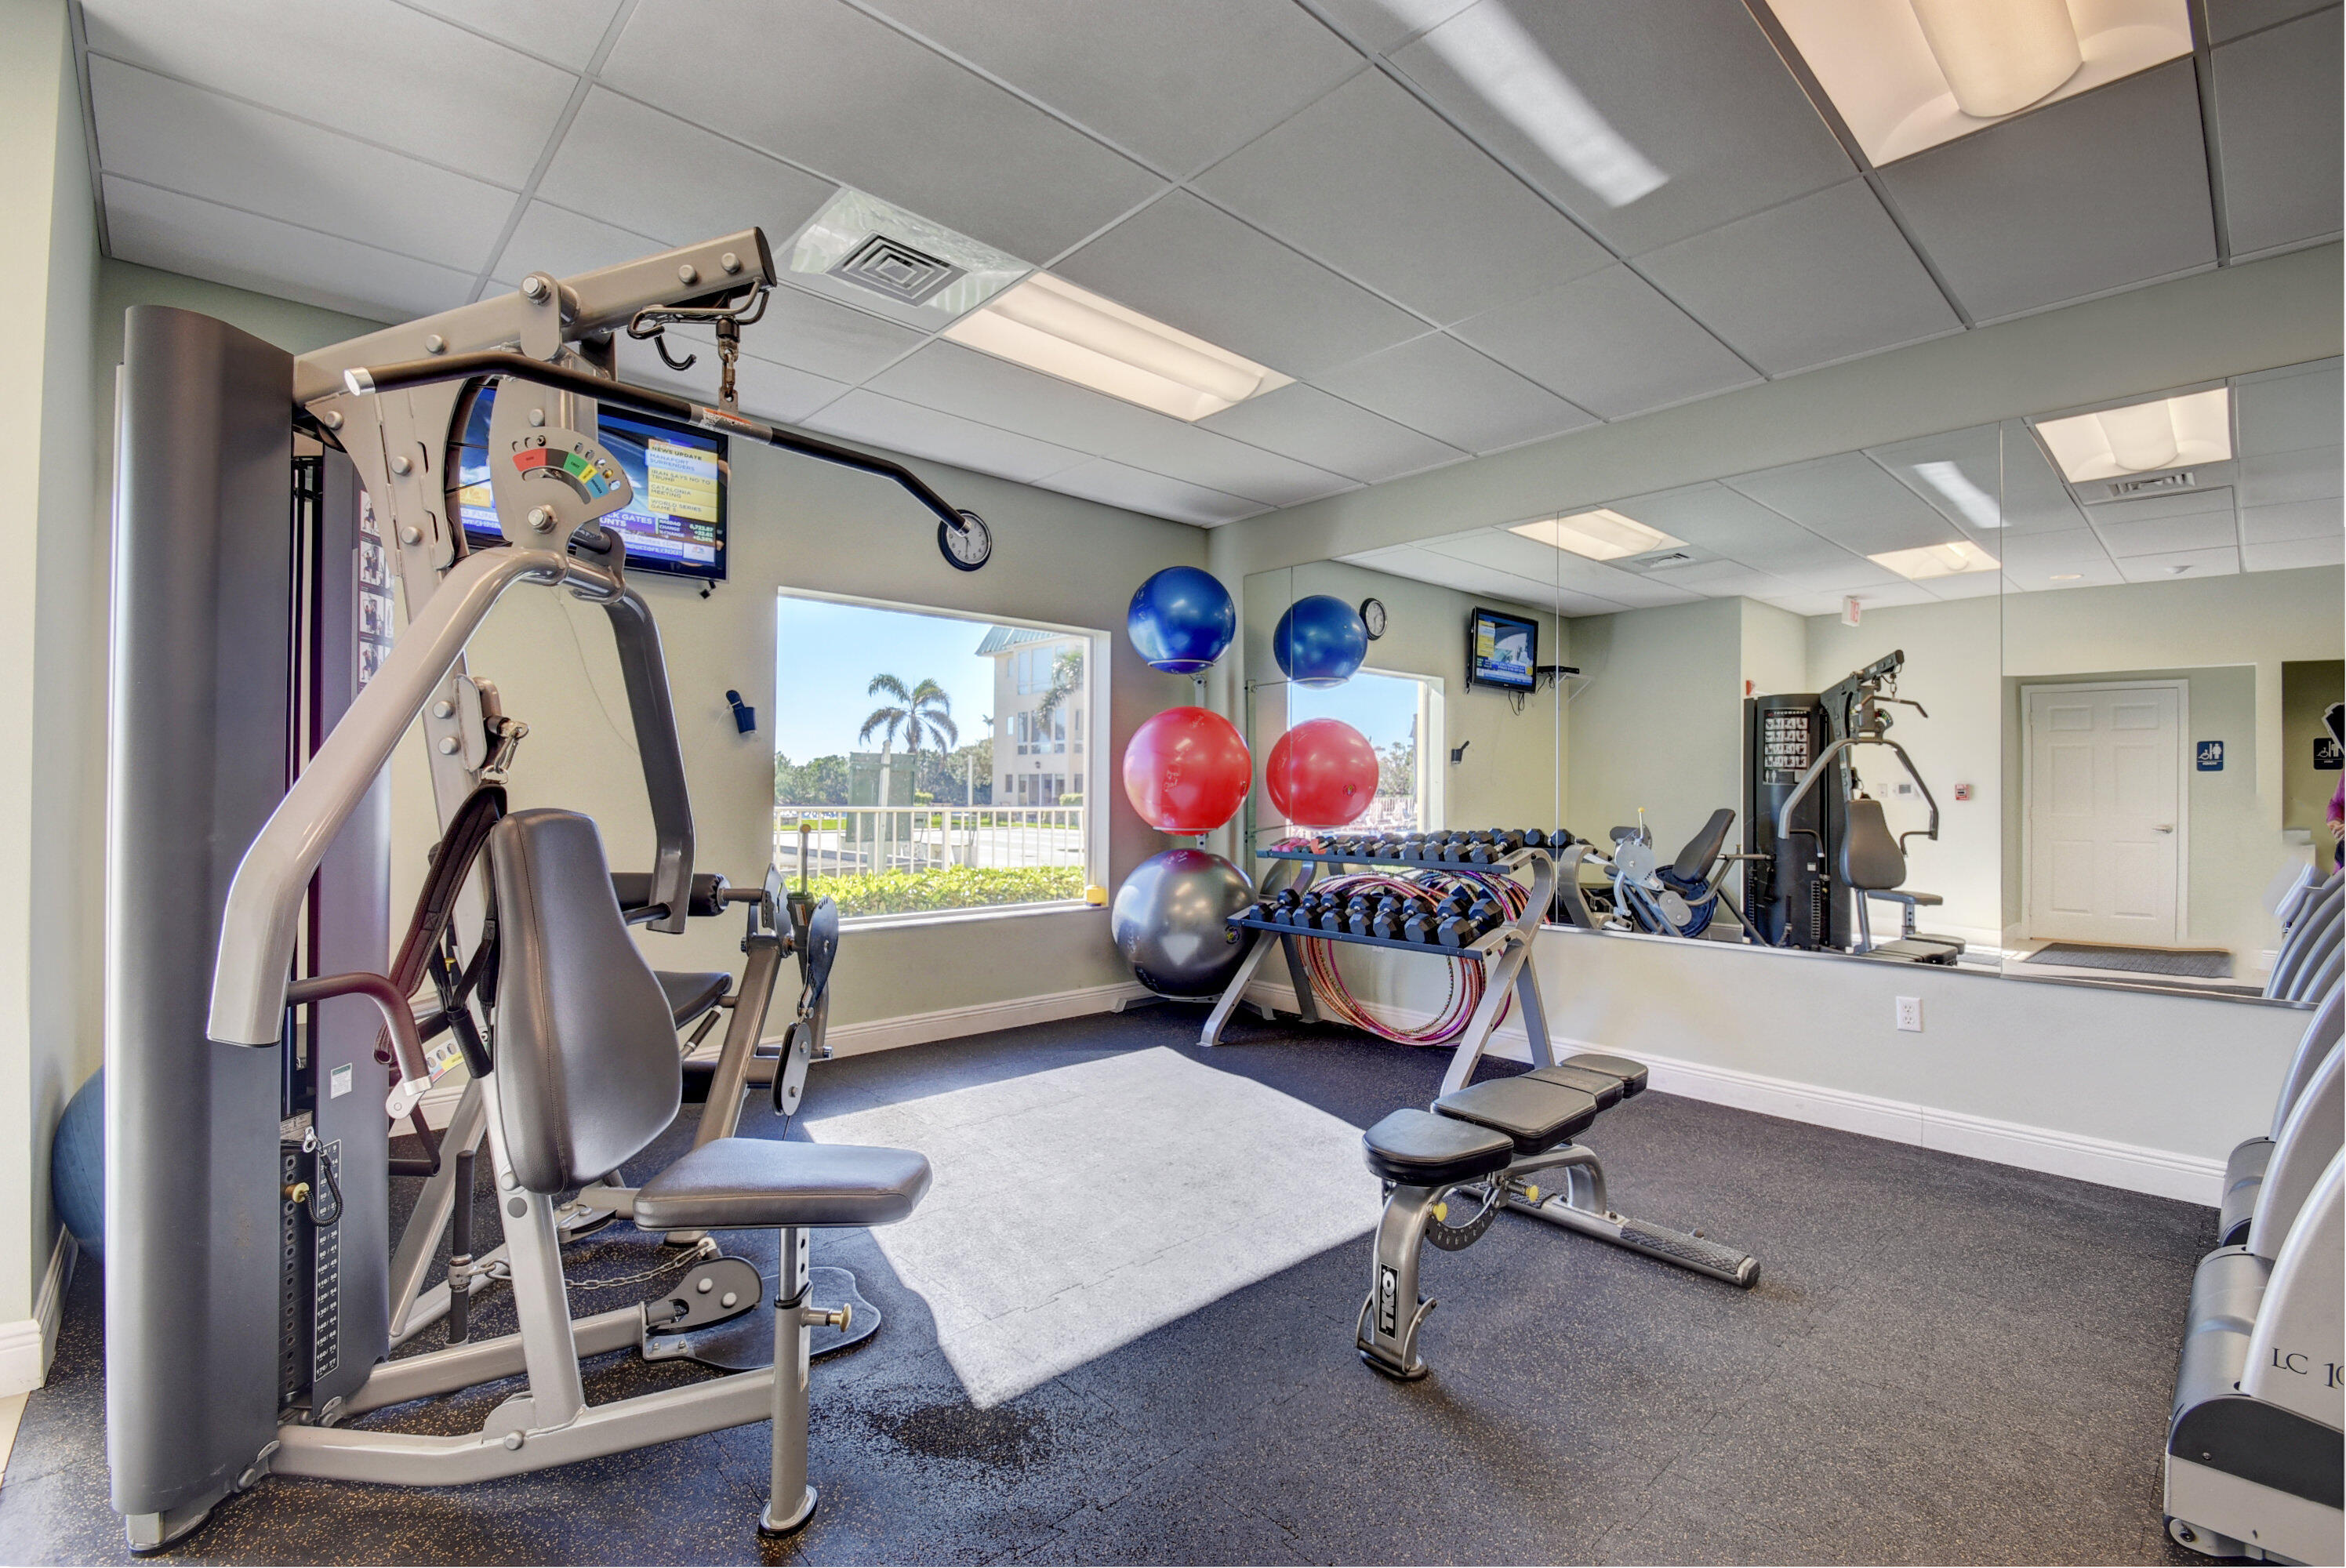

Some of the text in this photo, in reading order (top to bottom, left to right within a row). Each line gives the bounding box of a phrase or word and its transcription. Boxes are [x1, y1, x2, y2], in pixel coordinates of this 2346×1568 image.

[649, 452, 689, 465] MANAFORT
[652, 446, 703, 461] NEWS UPDATE
[649, 458, 695, 471] SURRENDERS
[651, 484, 692, 495] CATALONIA
[651, 488, 681, 499] MEETING
[652, 499, 702, 512] WORLD SERIES
[621, 513, 653, 524] GATES
[1381, 1271, 1396, 1330] TKO
[2271, 1347, 2308, 1375] LC
